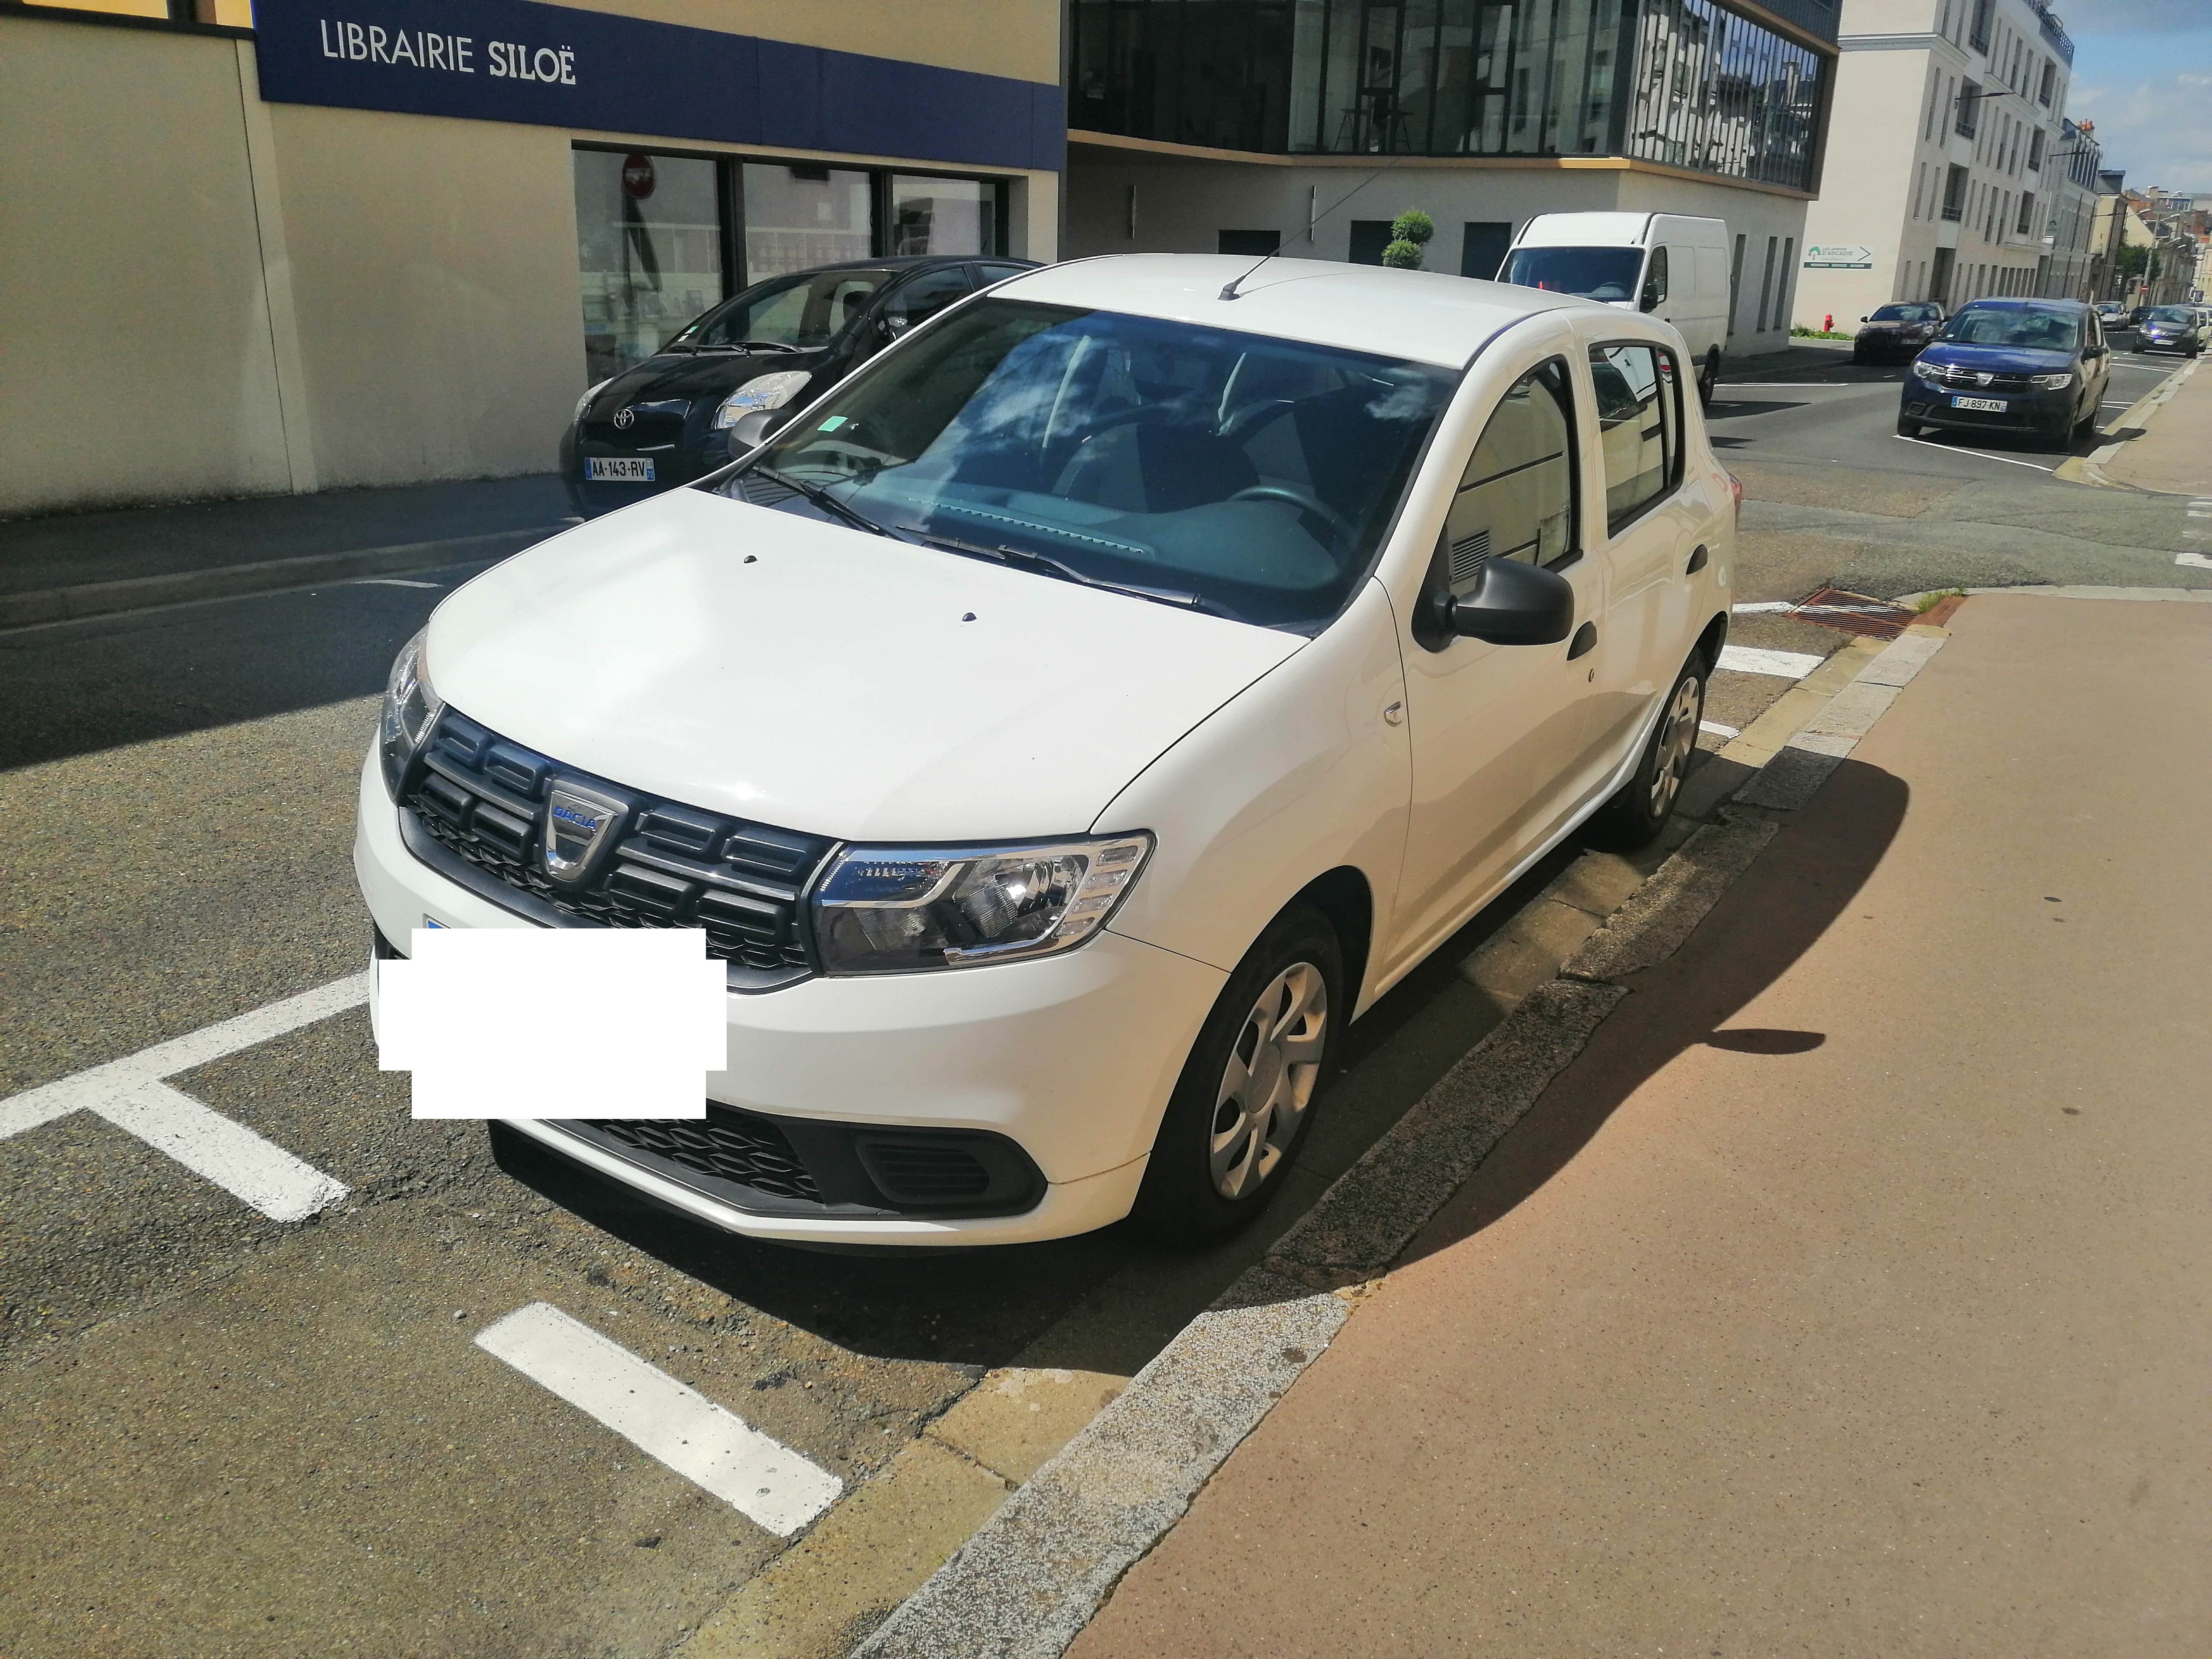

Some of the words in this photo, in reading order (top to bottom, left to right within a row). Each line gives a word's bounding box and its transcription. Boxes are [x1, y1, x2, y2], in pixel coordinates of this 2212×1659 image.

[321, 19, 474, 73] LIBRAIRIE
[488, 41, 576, 85] SILOË
[1958, 398, 2001, 410] FJ-897-KN
[593, 461, 645, 477] AA-143-RV
[553, 805, 596, 830] DACIA
